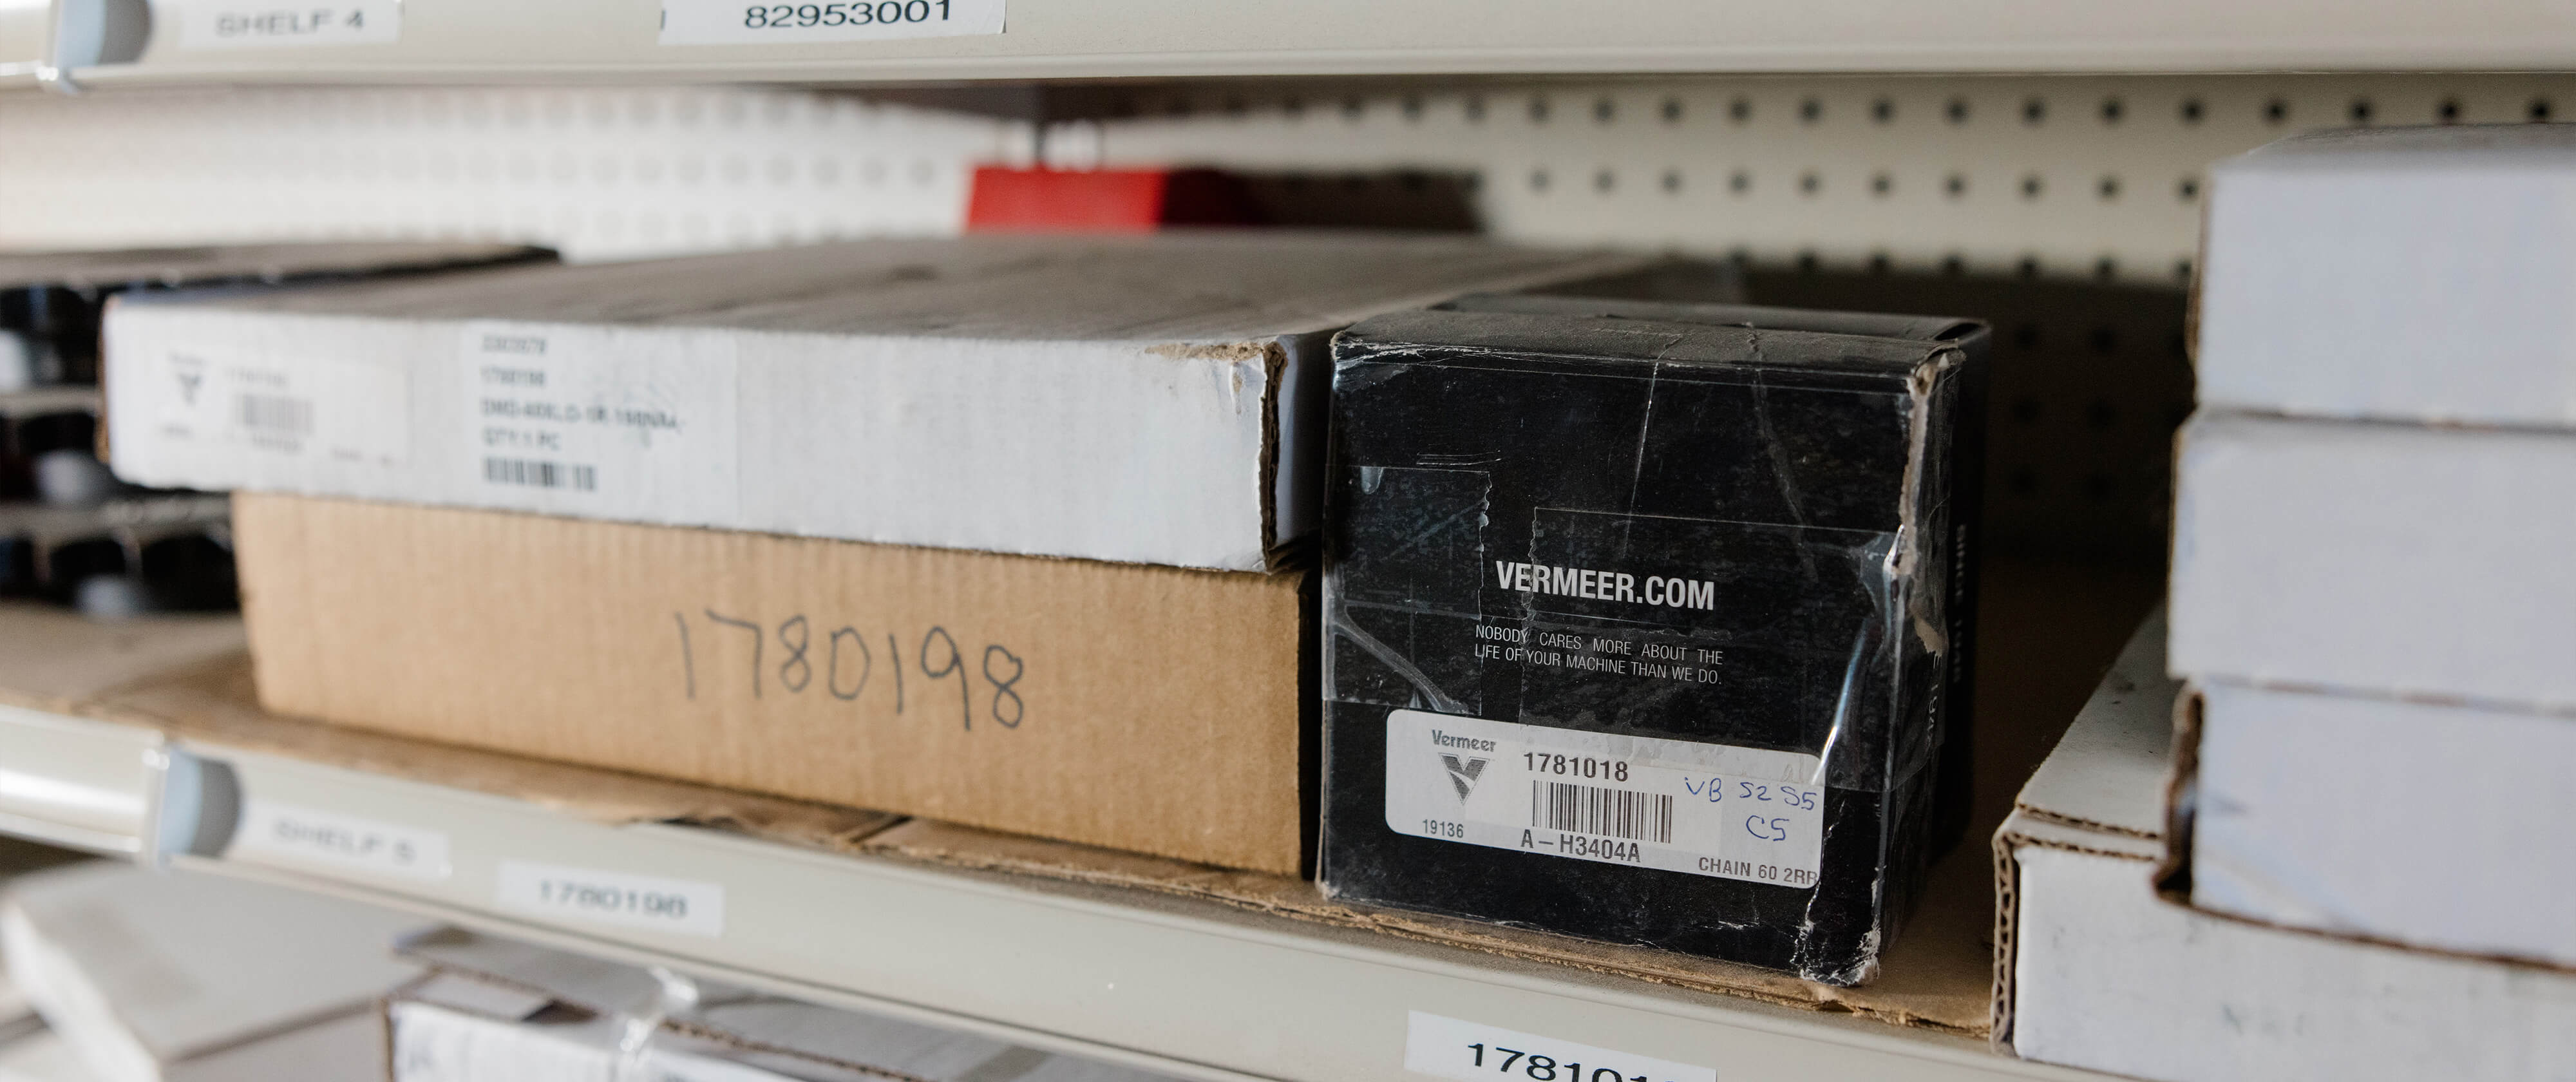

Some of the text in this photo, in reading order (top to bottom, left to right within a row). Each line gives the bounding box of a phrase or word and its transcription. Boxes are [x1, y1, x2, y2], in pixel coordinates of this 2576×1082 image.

[216, 8, 364, 37] SHELF 4
[744, 0, 950, 30] 82953001
[1495, 560, 1715, 611] VERMEER.COM
[1475, 624, 1723, 665] NOBODY CARES MORE ABOUT THE
[674, 608, 1025, 732] 1780198
[1475, 643, 1722, 685] LIFE OF YOUR MACHINE THAN WE DO.
[1431, 729, 1497, 753] Vermeer
[1523, 752, 1629, 783] 1781018
[1422, 818, 1464, 839] 19136
[1698, 857, 1751, 877] CHAIN
[1757, 864, 1777, 880] 60
[538, 879, 690, 919] 1780198
[1467, 1043, 1675, 1082] 17810
